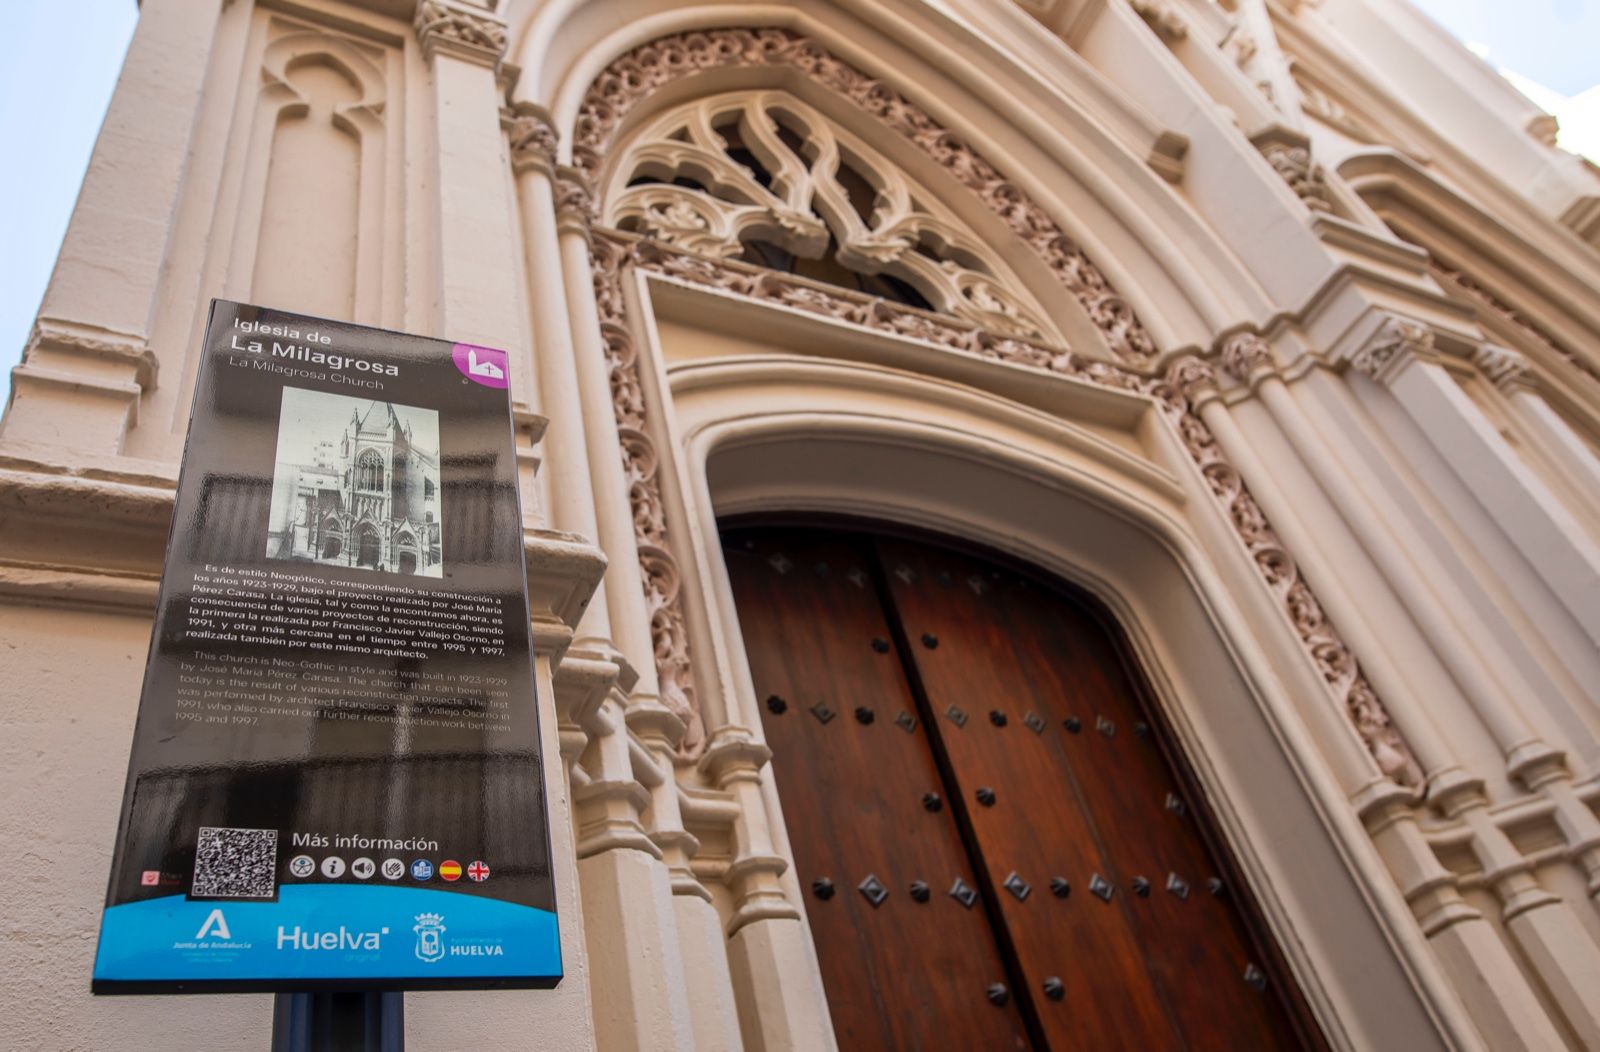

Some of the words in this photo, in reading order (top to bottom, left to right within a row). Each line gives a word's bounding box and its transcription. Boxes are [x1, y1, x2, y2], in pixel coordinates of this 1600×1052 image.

[234, 317, 300, 339] Iglesia
[306, 331, 331, 345] de
[229, 355, 248, 367] La
[253, 360, 326, 380] Milagrosa
[330, 373, 384, 390] Church
[231, 335, 262, 353] La
[272, 342, 399, 376] Milagrosa
[194, 574, 210, 582] los
[212, 575, 238, 585] años
[242, 579, 298, 592] 1923-1929,
[302, 585, 323, 595] bajo
[327, 588, 335, 596] el
[338, 590, 383, 601] proyecto
[386, 596, 430, 606] realizado
[433, 601, 448, 609] por
[451, 603, 474, 611] José
[205, 564, 218, 572] Es
[221, 566, 235, 574] de
[239, 568, 267, 578] estilo
[271, 572, 326, 585] Neogótico,
[330, 579, 414, 594] correspondiendo
[432, 591, 492, 603] construcción
[191, 597, 266, 610] consecuencia
[270, 603, 284, 612] de
[288, 606, 319, 616] varios
[323, 610, 373, 621] proyectos
[393, 617, 469, 632] reconstrucción,
[472, 625, 503, 635] siendo
[192, 584, 223, 595] Pérez
[227, 588, 266, 599] Carasa.
[271, 592, 283, 600] La
[287, 594, 322, 606] iglesia,
[325, 599, 338, 607] tal
[351, 602, 379, 611] como
[393, 607, 457, 619] encontramos
[460, 614, 488, 624] ahora,
[188, 618, 215, 628] 1991,
[221, 622, 228, 630] y
[234, 623, 256, 632] otra
[262, 625, 284, 634] más
[290, 628, 333, 639] cercana
[339, 633, 351, 641] en
[371, 635, 406, 646] tiempo
[411, 641, 438, 649] entre
[443, 643, 465, 652] 1995
[482, 646, 505, 657] 1997,
[202, 608, 245, 619] primera
[249, 611, 258, 620] la
[261, 613, 309, 626] realizada
[312, 620, 329, 629] por
[333, 620, 382, 633] Francisco
[385, 626, 415, 636] Javier
[418, 630, 450, 640] Vallejo
[453, 634, 490, 644] Osorno,
[186, 630, 237, 641] realizada
[241, 635, 285, 646] también
[289, 640, 306, 649] por
[310, 642, 332, 650] este
[336, 644, 370, 654] mismo
[373, 648, 428, 660] arquitecto.
[180, 662, 195, 672] by
[348, 676, 367, 685] The
[370, 678, 406, 689] church
[411, 682, 430, 691] that
[436, 685, 453, 693] can
[457, 685, 481, 696] been
[194, 650, 216, 660] This
[219, 654, 258, 664] church
[261, 657, 269, 665] is
[272, 658, 334, 671] Neo-Gothic
[339, 662, 347, 672] in
[350, 666, 375, 676] style
[379, 668, 397, 677] and
[400, 671, 420, 679] was
[423, 671, 443, 681] built
[177, 688, 200, 696] was
[204, 689, 265, 702] performed
[269, 693, 283, 703] by
[287, 696, 334, 707] architect
[339, 699, 389, 711] Francisco
[428, 707, 460, 717] Vallejo
[462, 709, 498, 719] Osorno
[180, 675, 212, 686] today
[217, 678, 225, 686] is
[230, 678, 247, 688] the
[251, 681, 281, 690] result
[286, 683, 297, 692] of
[301, 685, 339, 695] various
[343, 689, 418, 701] reconstruction
[490, 700, 509, 709] first
[175, 711, 202, 722] 1995
[205, 714, 227, 723] and
[207, 701, 232, 711] who
[234, 704, 257, 713] also
[260, 705, 298, 717] carried
[302, 709, 320, 718] out
[324, 710, 360, 720] further
[363, 710, 439, 727] reconstruction
[442, 719, 465, 729] work
[468, 721, 510, 732] between
[292, 832, 329, 848] Más
[336, 834, 439, 852] información
[173, 941, 196, 949] Junta
[450, 945, 504, 956] HUELVA
